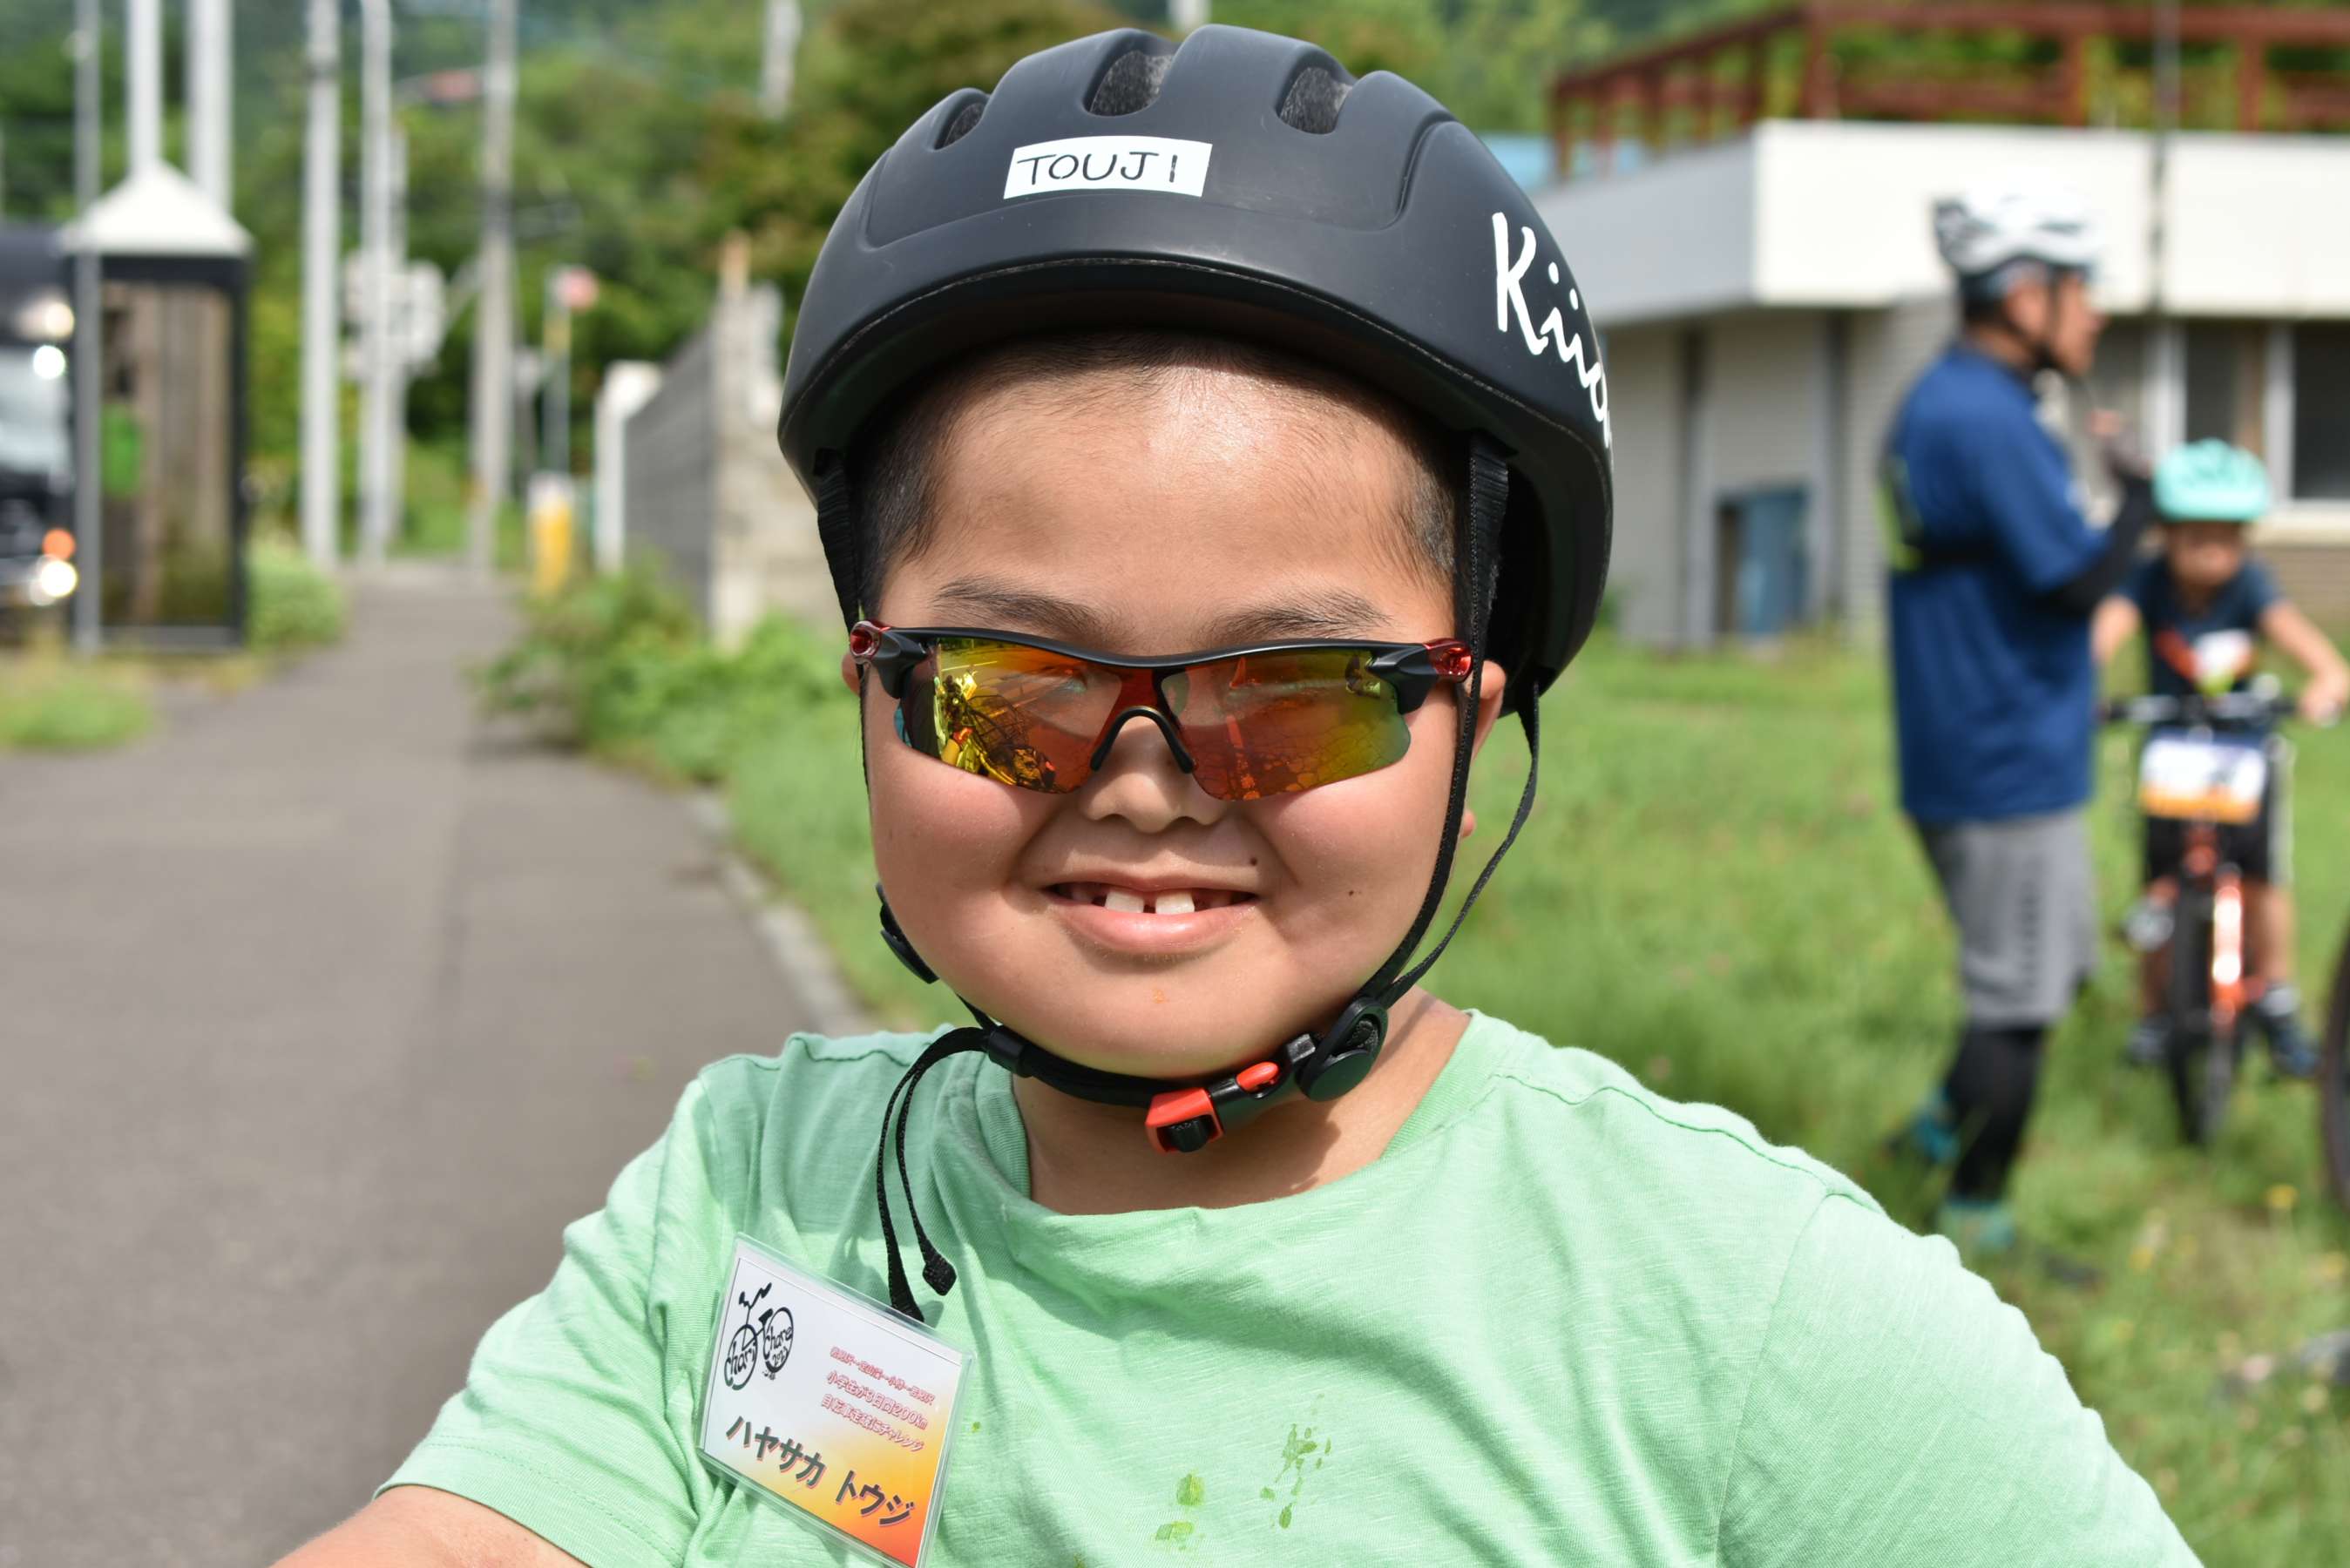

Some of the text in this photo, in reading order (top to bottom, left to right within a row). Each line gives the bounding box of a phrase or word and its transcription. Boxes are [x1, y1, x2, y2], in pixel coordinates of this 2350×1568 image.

[1016, 151, 1178, 186] TOUJI
[726, 1416, 915, 1527] ハヤサカ トウジ
